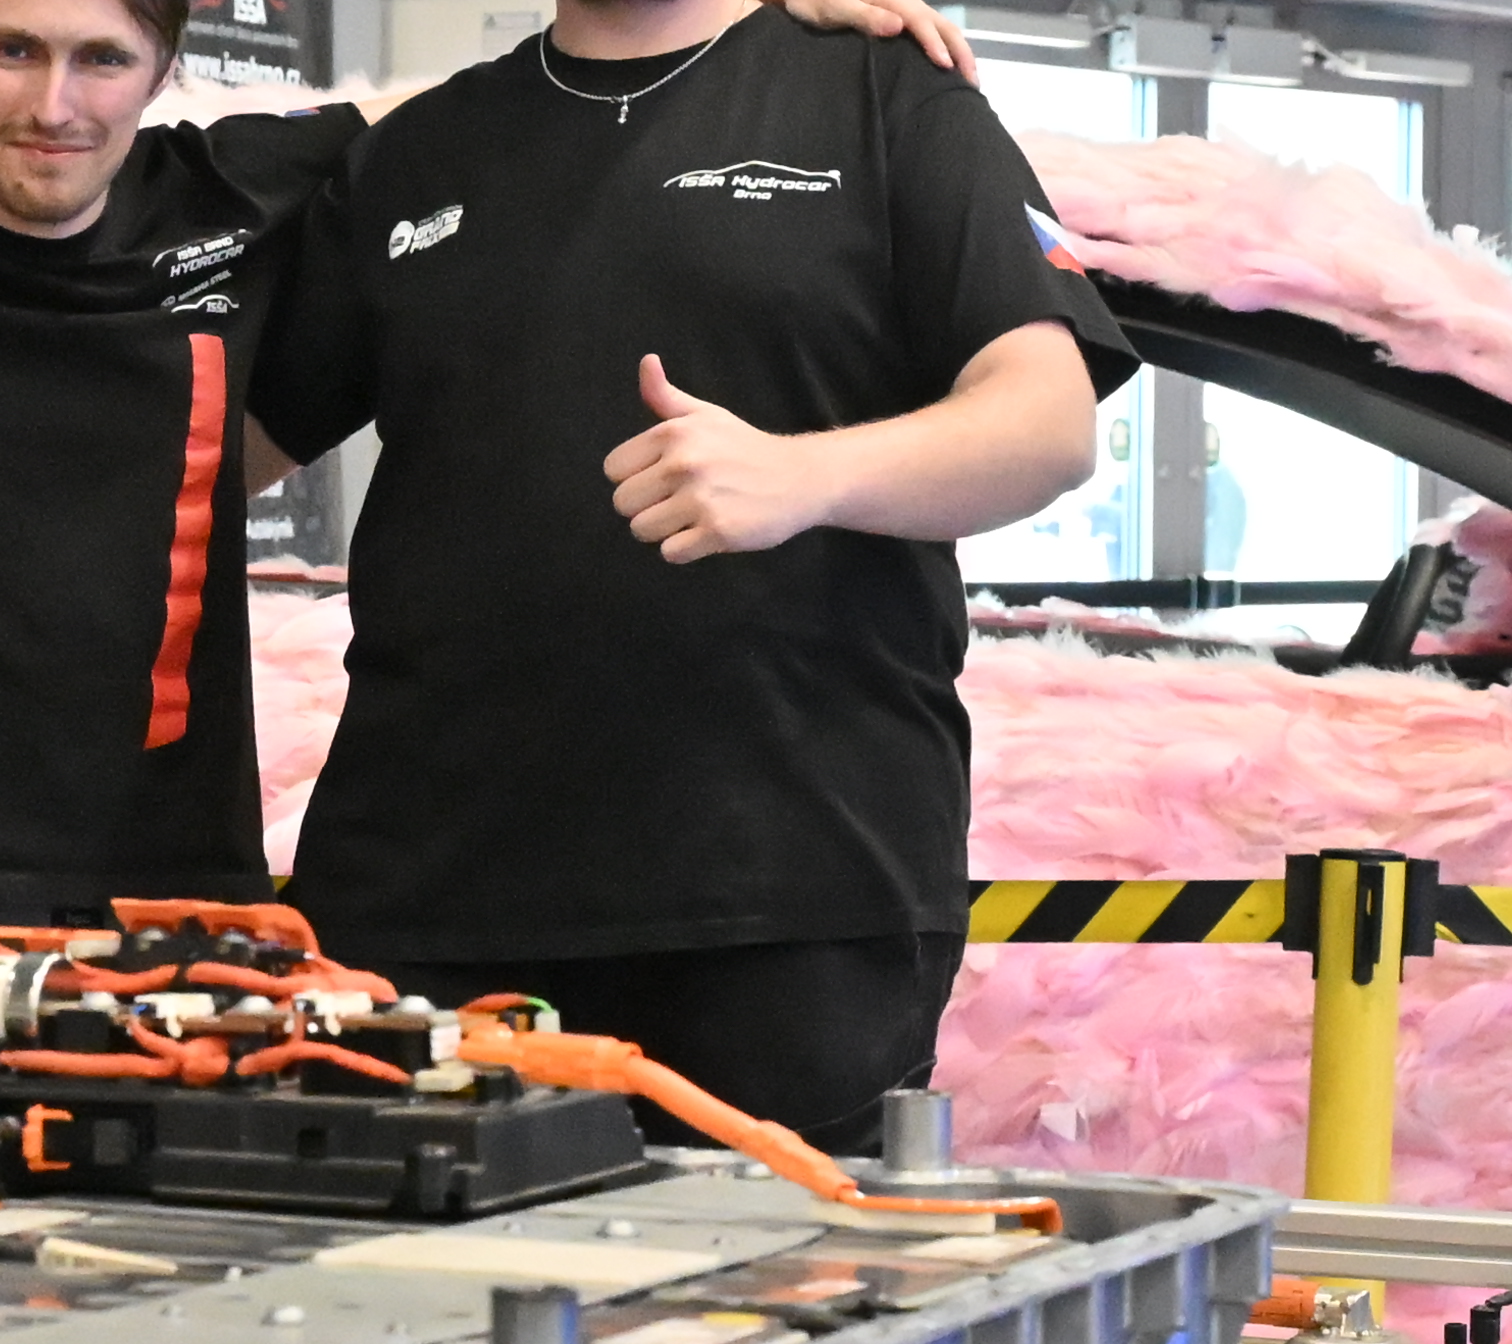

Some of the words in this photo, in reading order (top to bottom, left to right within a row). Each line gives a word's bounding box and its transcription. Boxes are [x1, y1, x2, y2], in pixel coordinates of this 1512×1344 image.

[731, 174, 832, 192] Hydrocar
[732, 188, 773, 201] Brno
[169, 243, 245, 278] HYDROCAR
